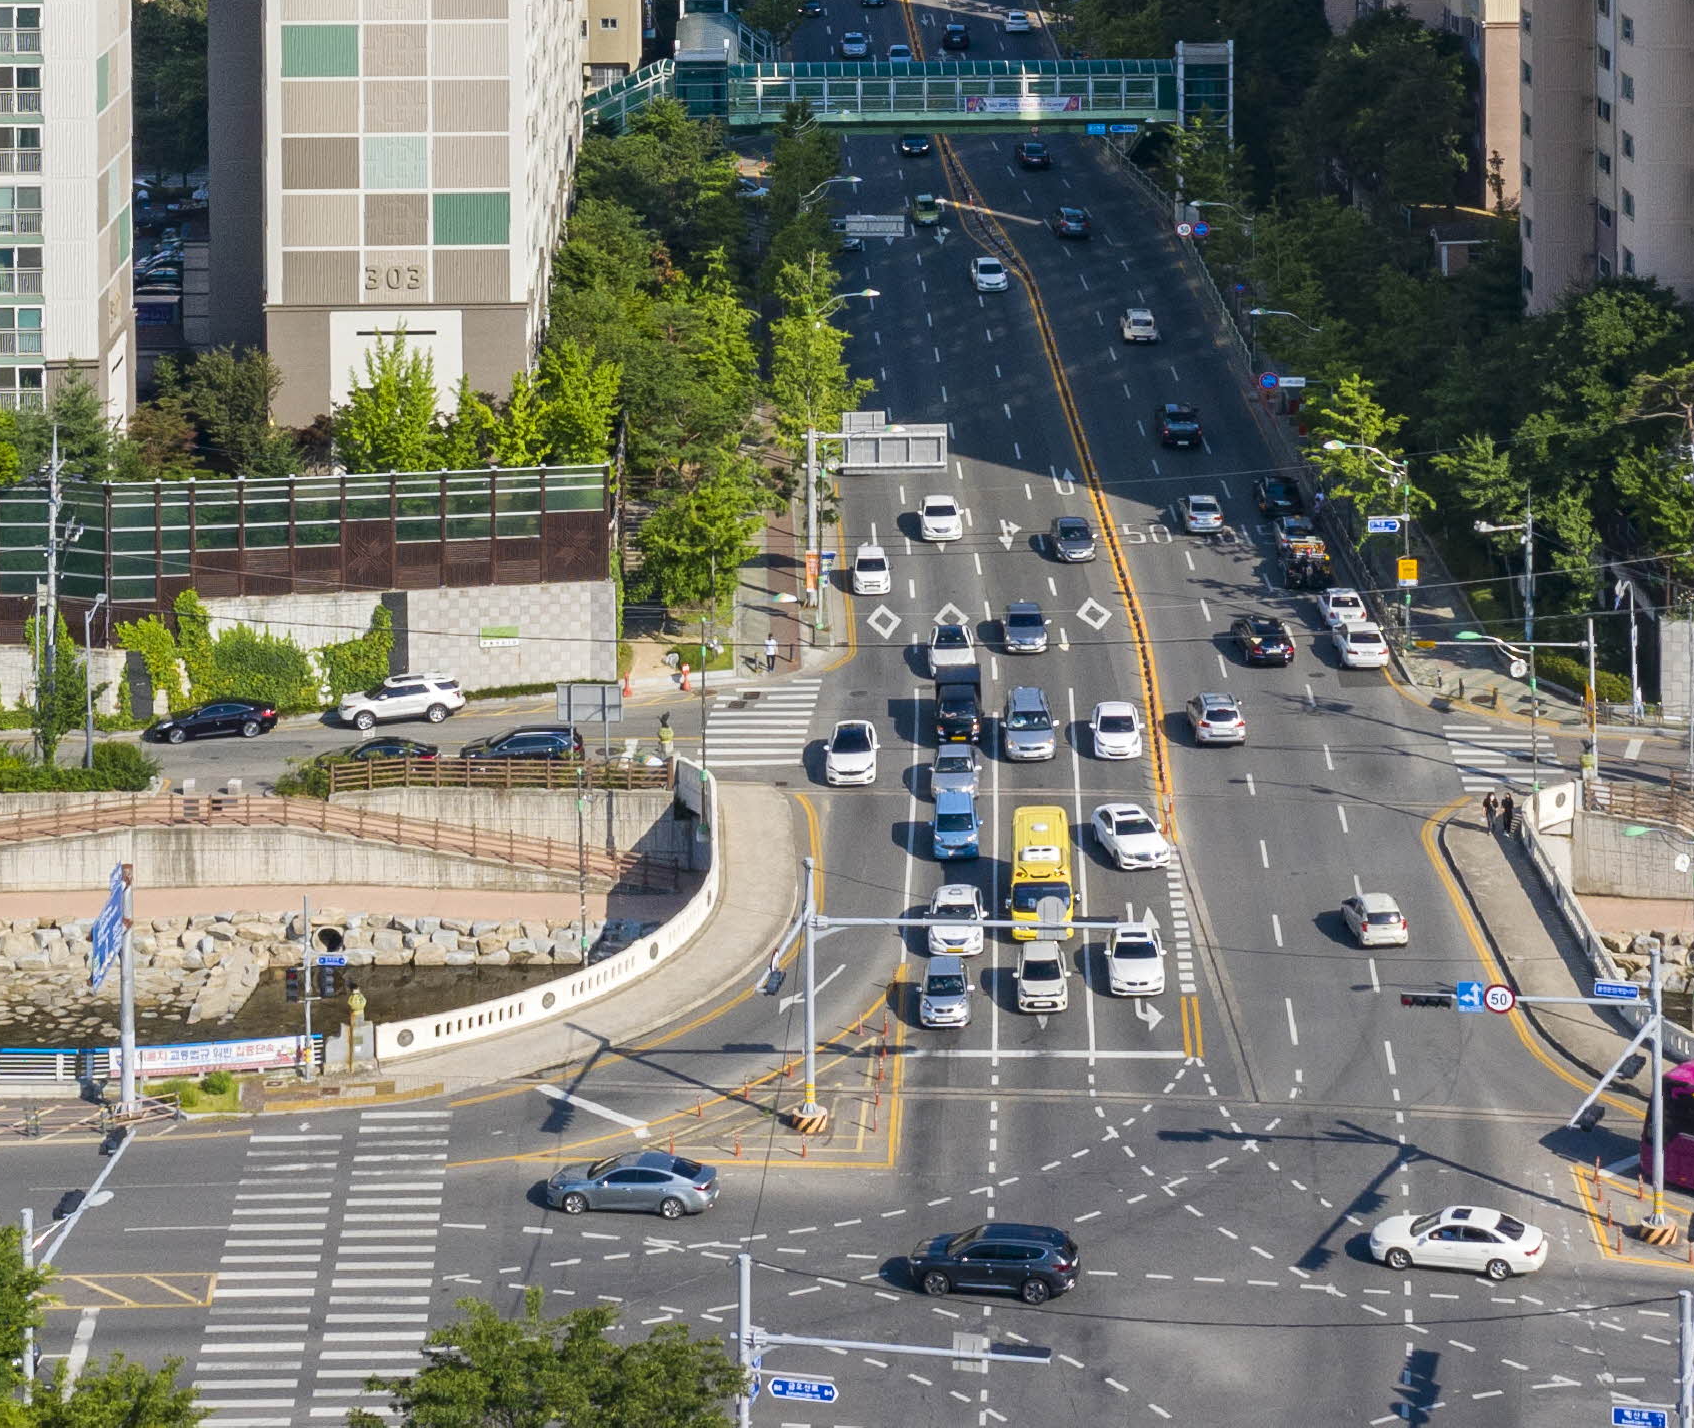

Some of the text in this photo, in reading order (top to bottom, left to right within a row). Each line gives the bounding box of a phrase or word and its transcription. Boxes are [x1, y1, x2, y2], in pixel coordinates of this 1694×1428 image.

[364, 264, 424, 291] 303
[1121, 522, 1174, 545] 50
[1490, 993, 1509, 1006] 50
